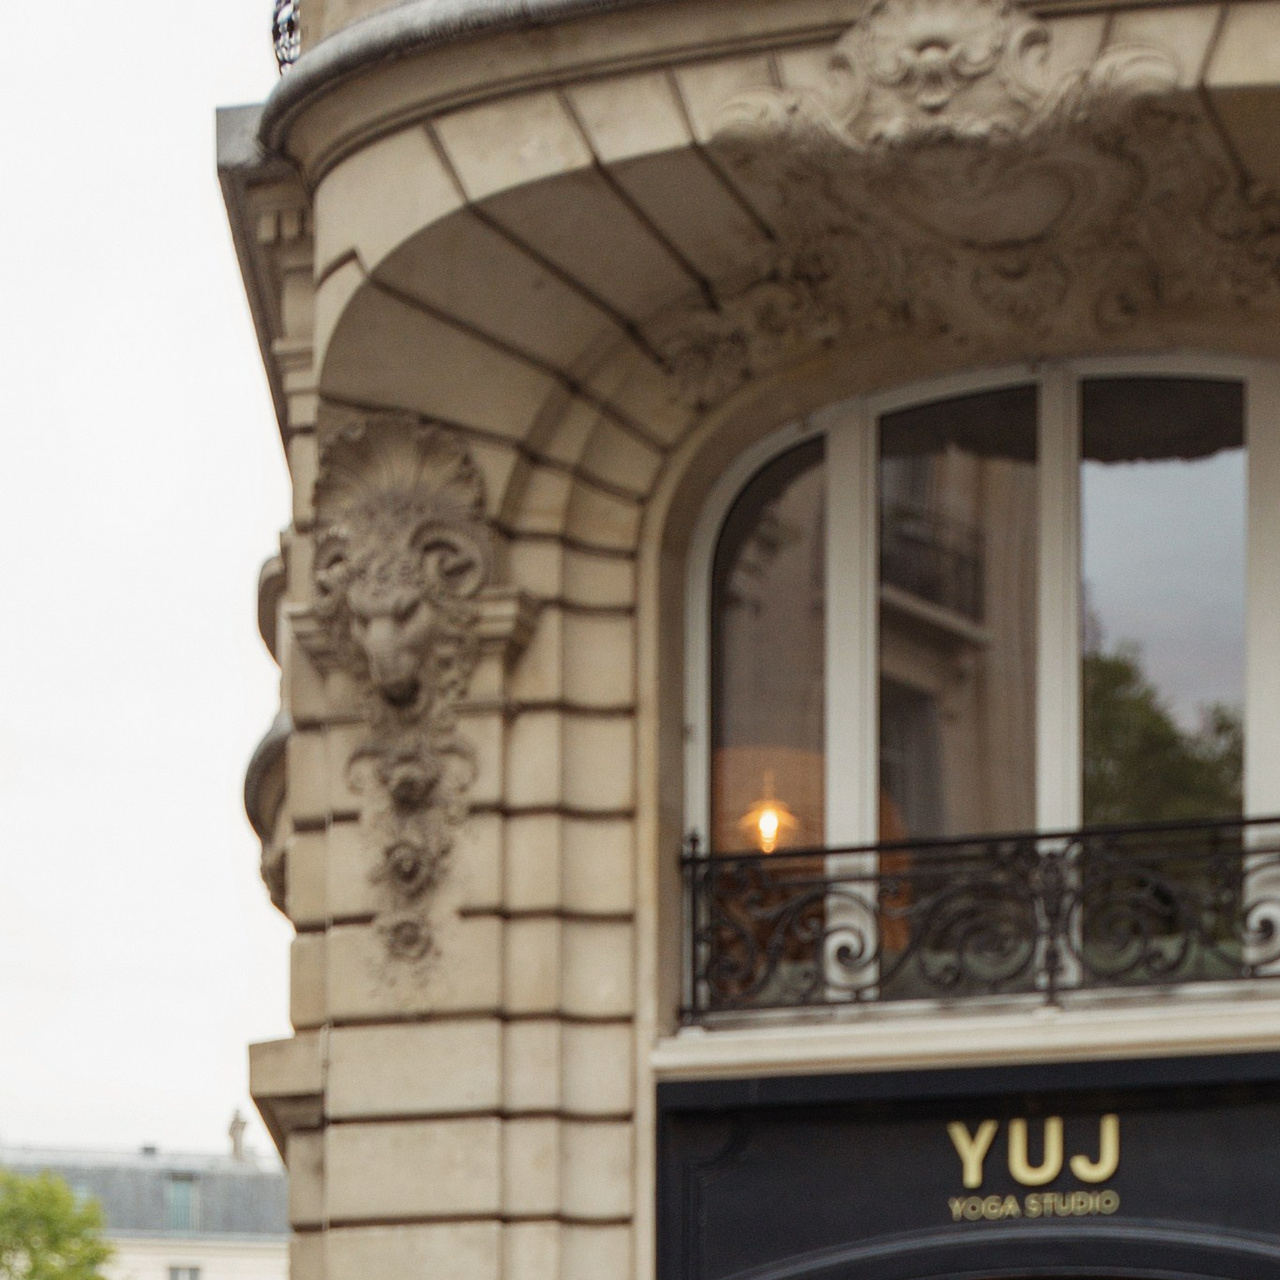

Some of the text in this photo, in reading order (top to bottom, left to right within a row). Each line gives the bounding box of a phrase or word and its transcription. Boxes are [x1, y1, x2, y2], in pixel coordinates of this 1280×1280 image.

[947, 1113, 1120, 1189] YUJ
[948, 1189, 1121, 1222] YOGA STUDIO
